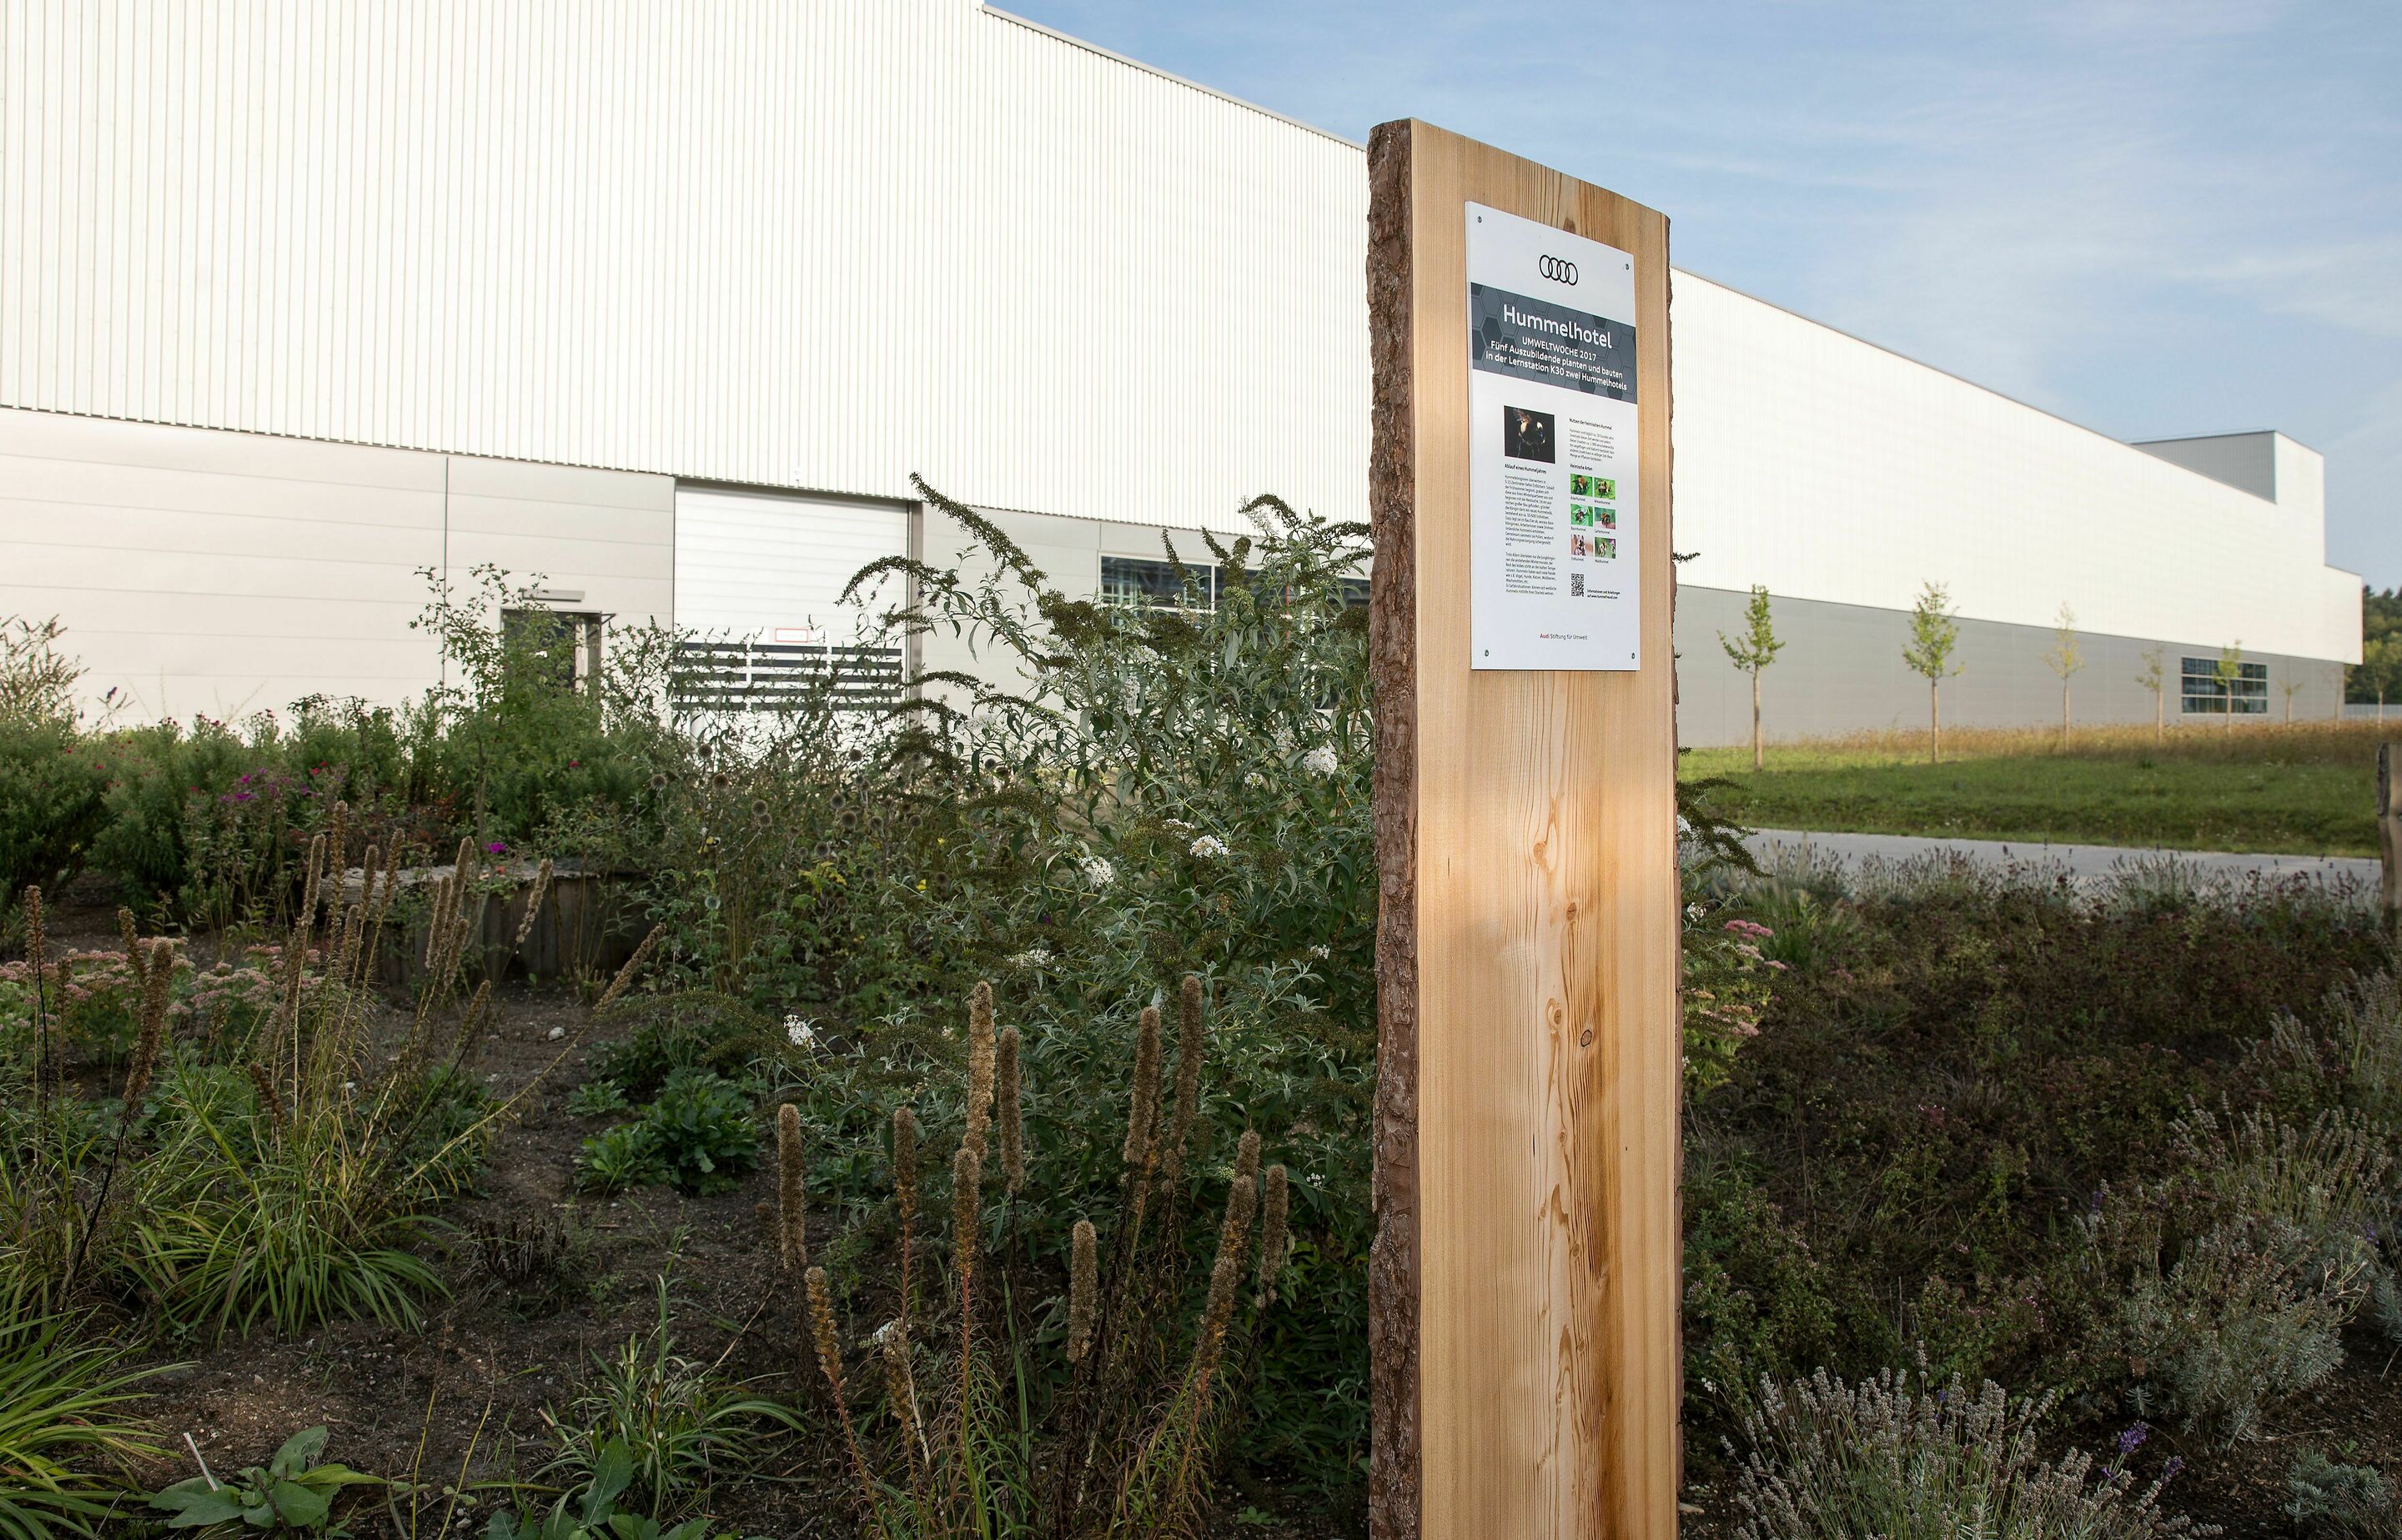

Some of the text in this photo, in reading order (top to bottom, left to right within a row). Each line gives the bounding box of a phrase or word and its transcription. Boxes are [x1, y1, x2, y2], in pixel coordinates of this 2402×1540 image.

[1503, 303, 1612, 349] Hummelhotel
[1491, 340, 1623, 379] Fünf Auszubildende planten und bauten
[1522, 336, 1597, 361] UMWELTWOCHE 2017
[1485, 351, 1627, 391] in der Lernstation K30 zwei Hummelhotels
